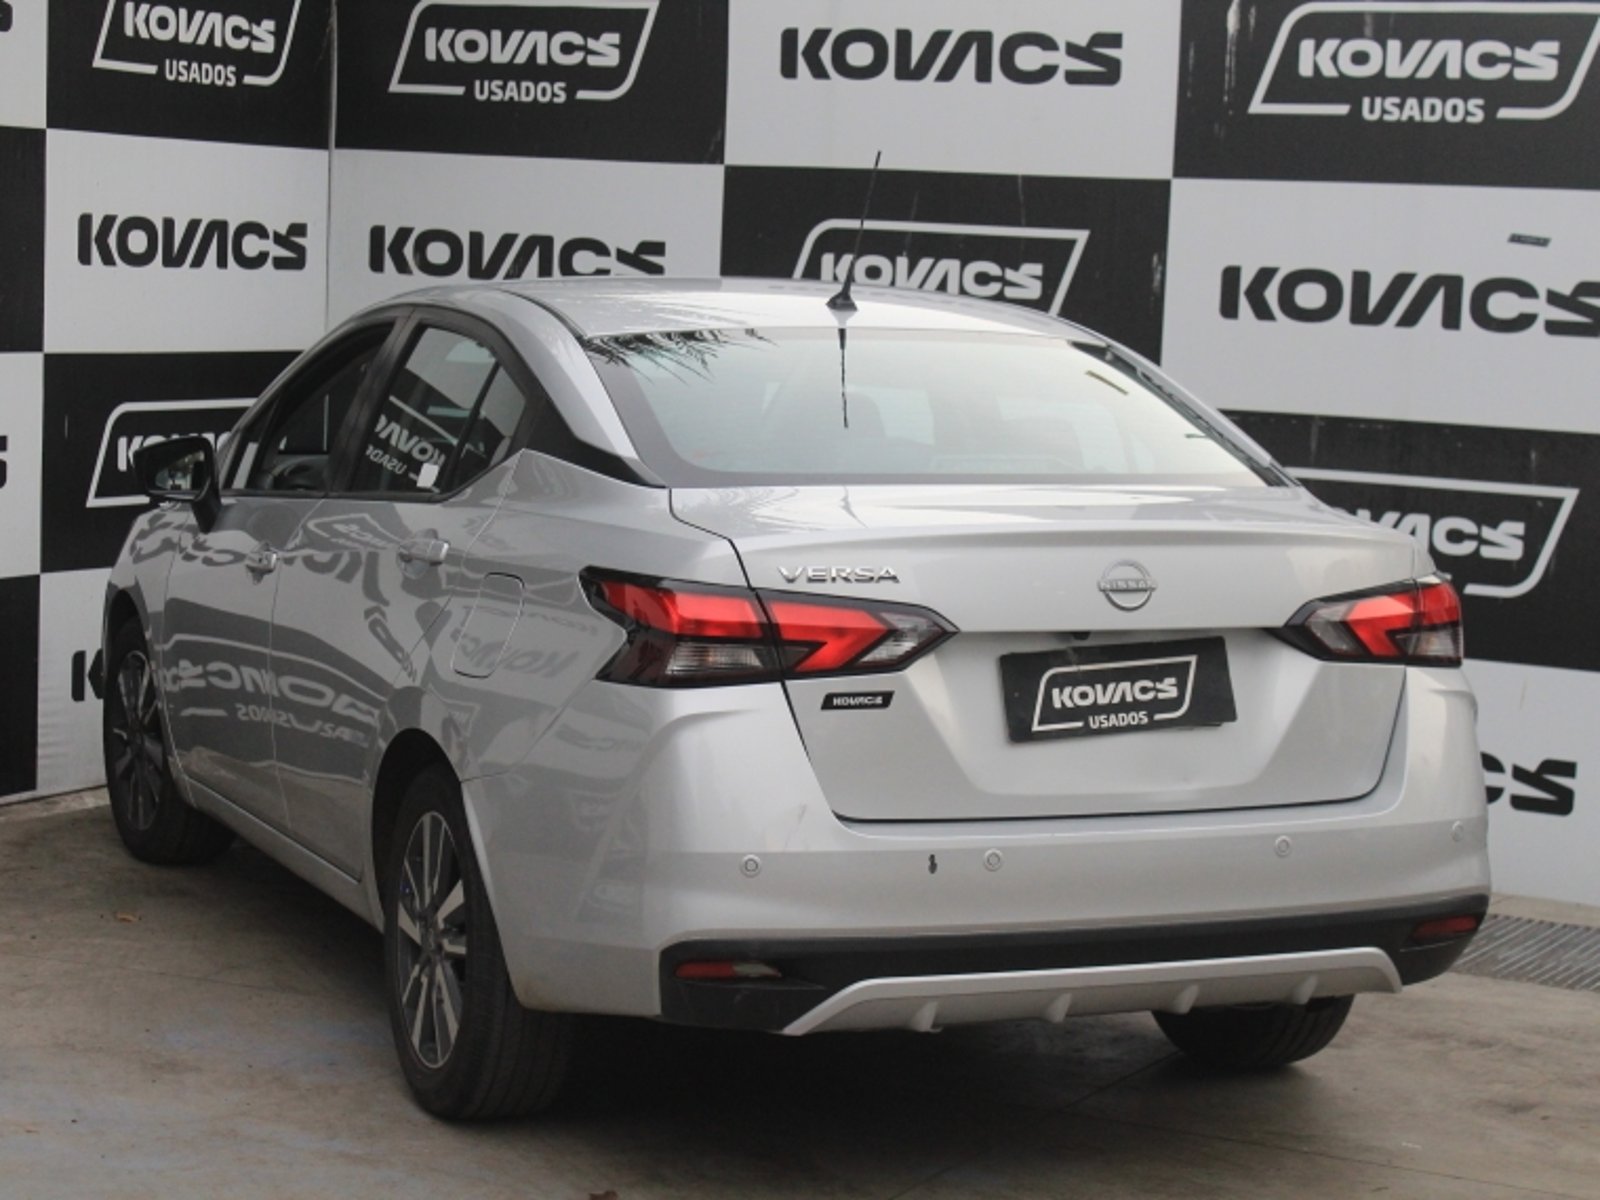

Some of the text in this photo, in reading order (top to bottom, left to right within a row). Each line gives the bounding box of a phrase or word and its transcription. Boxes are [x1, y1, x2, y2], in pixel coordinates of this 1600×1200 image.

[123, 1, 276, 54] KOVACS
[425, 27, 621, 67] KOVACS
[164, 58, 237, 87] USADOS
[780, 27, 1123, 87] KOVACS
[1298, 38, 1560, 81] KOVACS
[474, 79, 567, 104] USADOS
[1361, 96, 1485, 124] USADOS
[77, 212, 308, 271] KOVACS
[368, 224, 666, 281] KOVACS
[820, 252, 1044, 300] KOVACS
[1219, 265, 1600, 339] KOVACS
[778, 565, 901, 584] VERSA
[832, 695, 884, 707] KOVACS
[1052, 677, 1179, 709] KOVACS
[1088, 710, 1149, 730] USADOS
